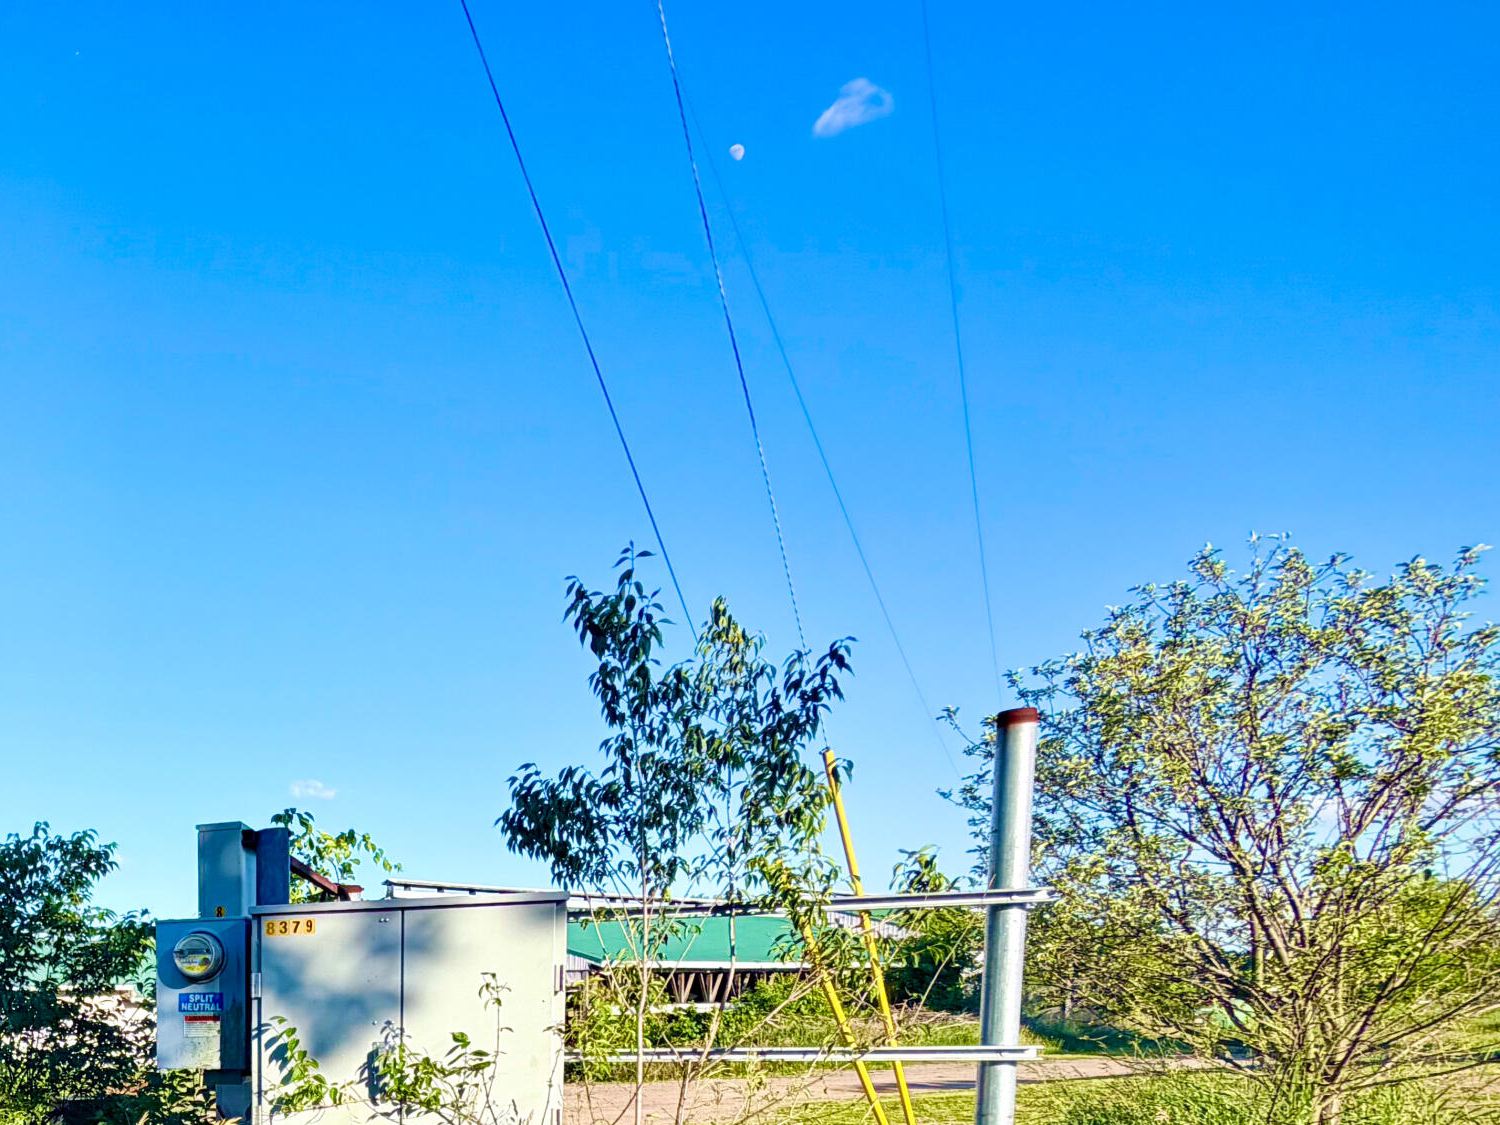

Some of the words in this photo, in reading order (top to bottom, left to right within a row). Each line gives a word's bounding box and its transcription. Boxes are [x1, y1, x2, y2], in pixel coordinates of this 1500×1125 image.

[265, 919, 313, 936] 8379
[188, 994, 214, 1003] SPLIT
[181, 1002, 222, 1012] NEUTRAL
